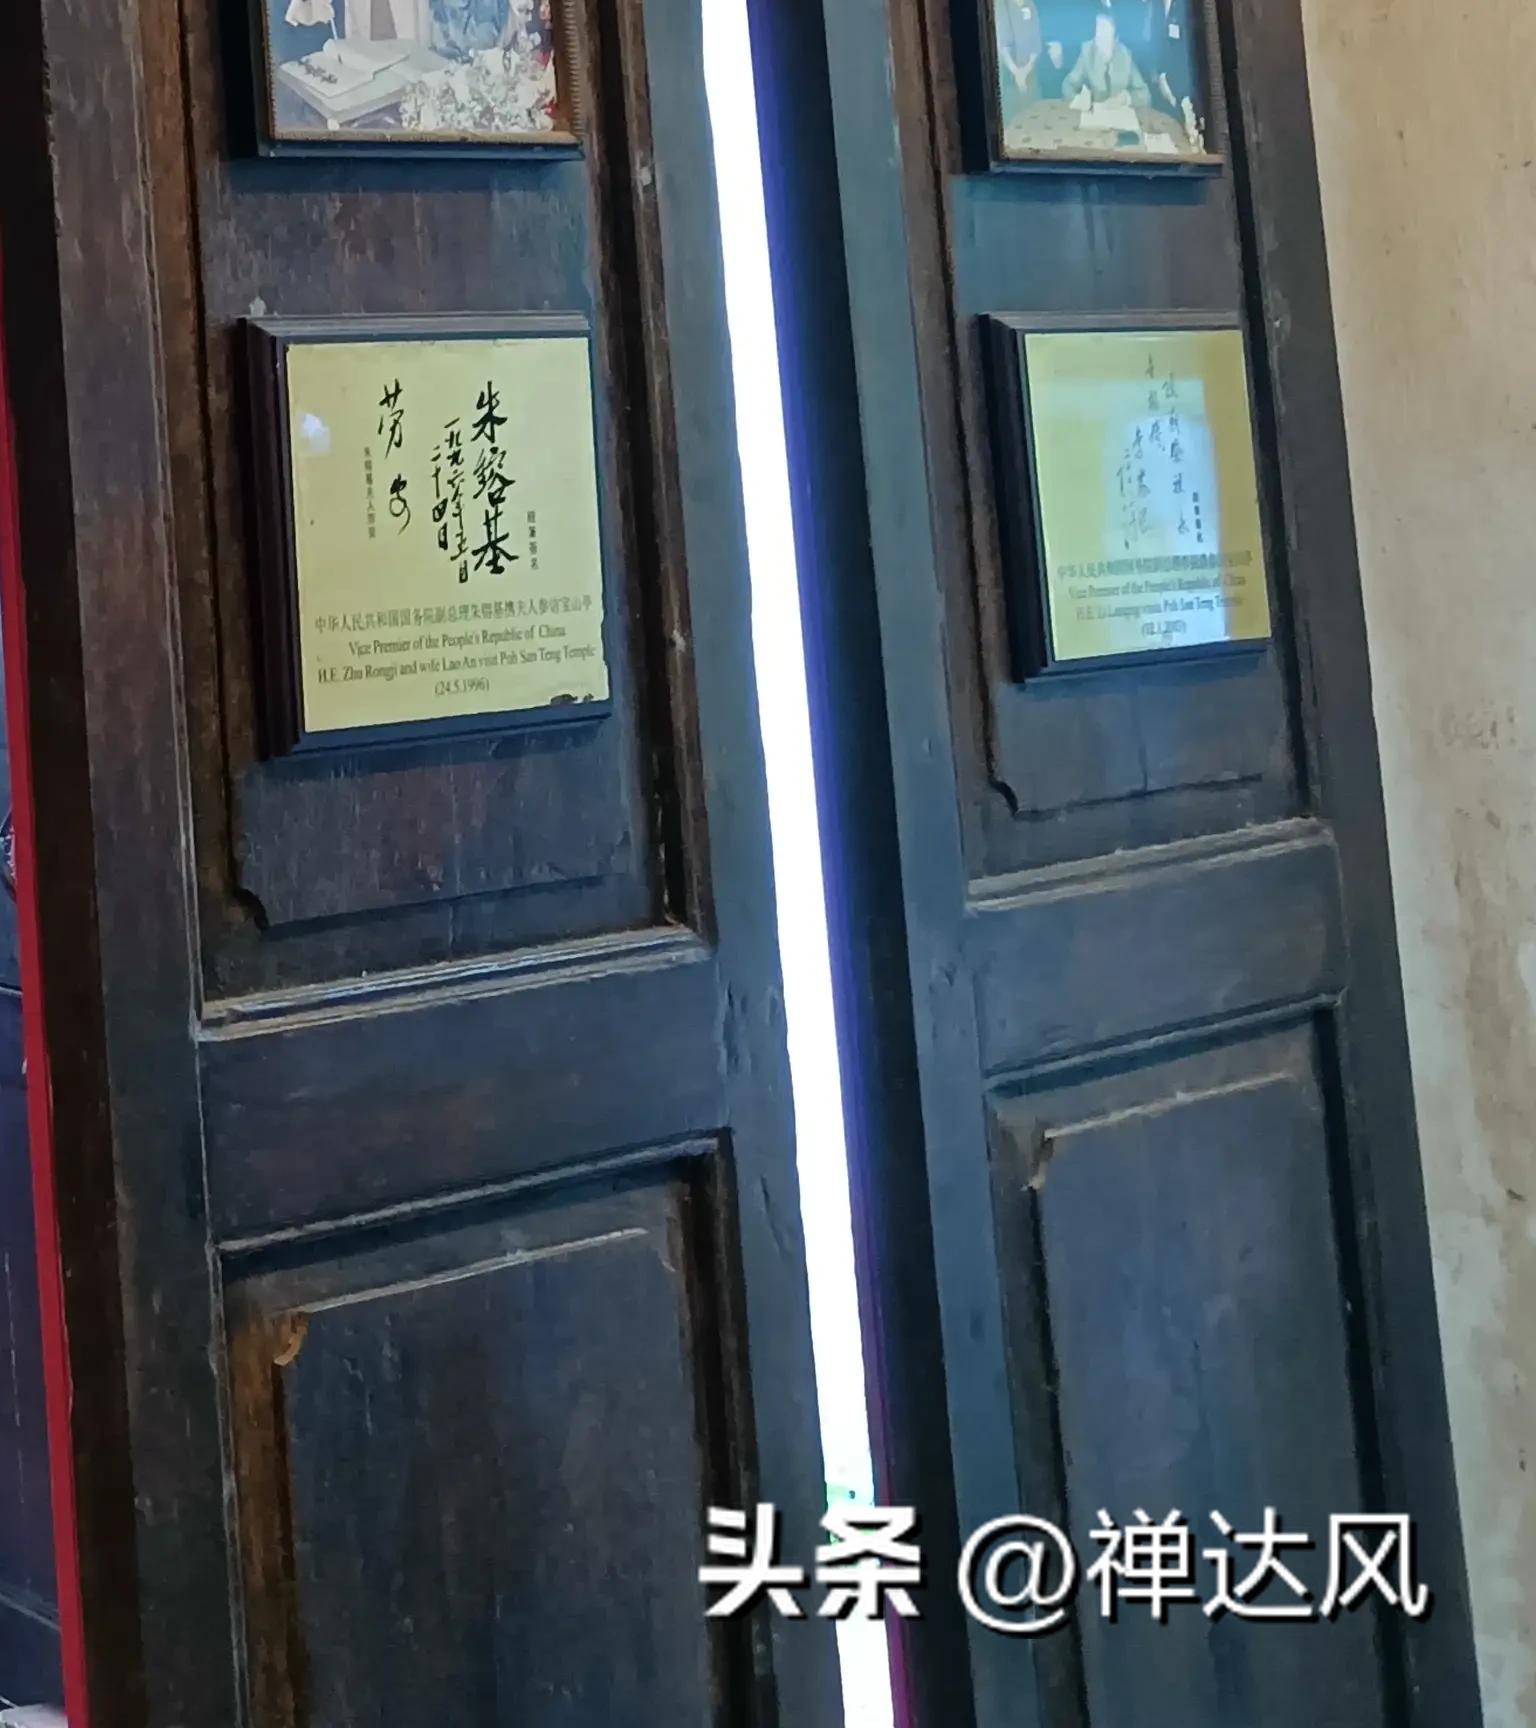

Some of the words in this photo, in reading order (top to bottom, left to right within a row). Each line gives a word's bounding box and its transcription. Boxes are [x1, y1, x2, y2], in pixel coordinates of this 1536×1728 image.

[349, 640, 371, 656] Vice
[413, 635, 425, 650] of
[425, 632, 439, 649] the
[524, 624, 535, 640] of
[400, 660, 418, 676] and
[538, 647, 561, 663] Teng
